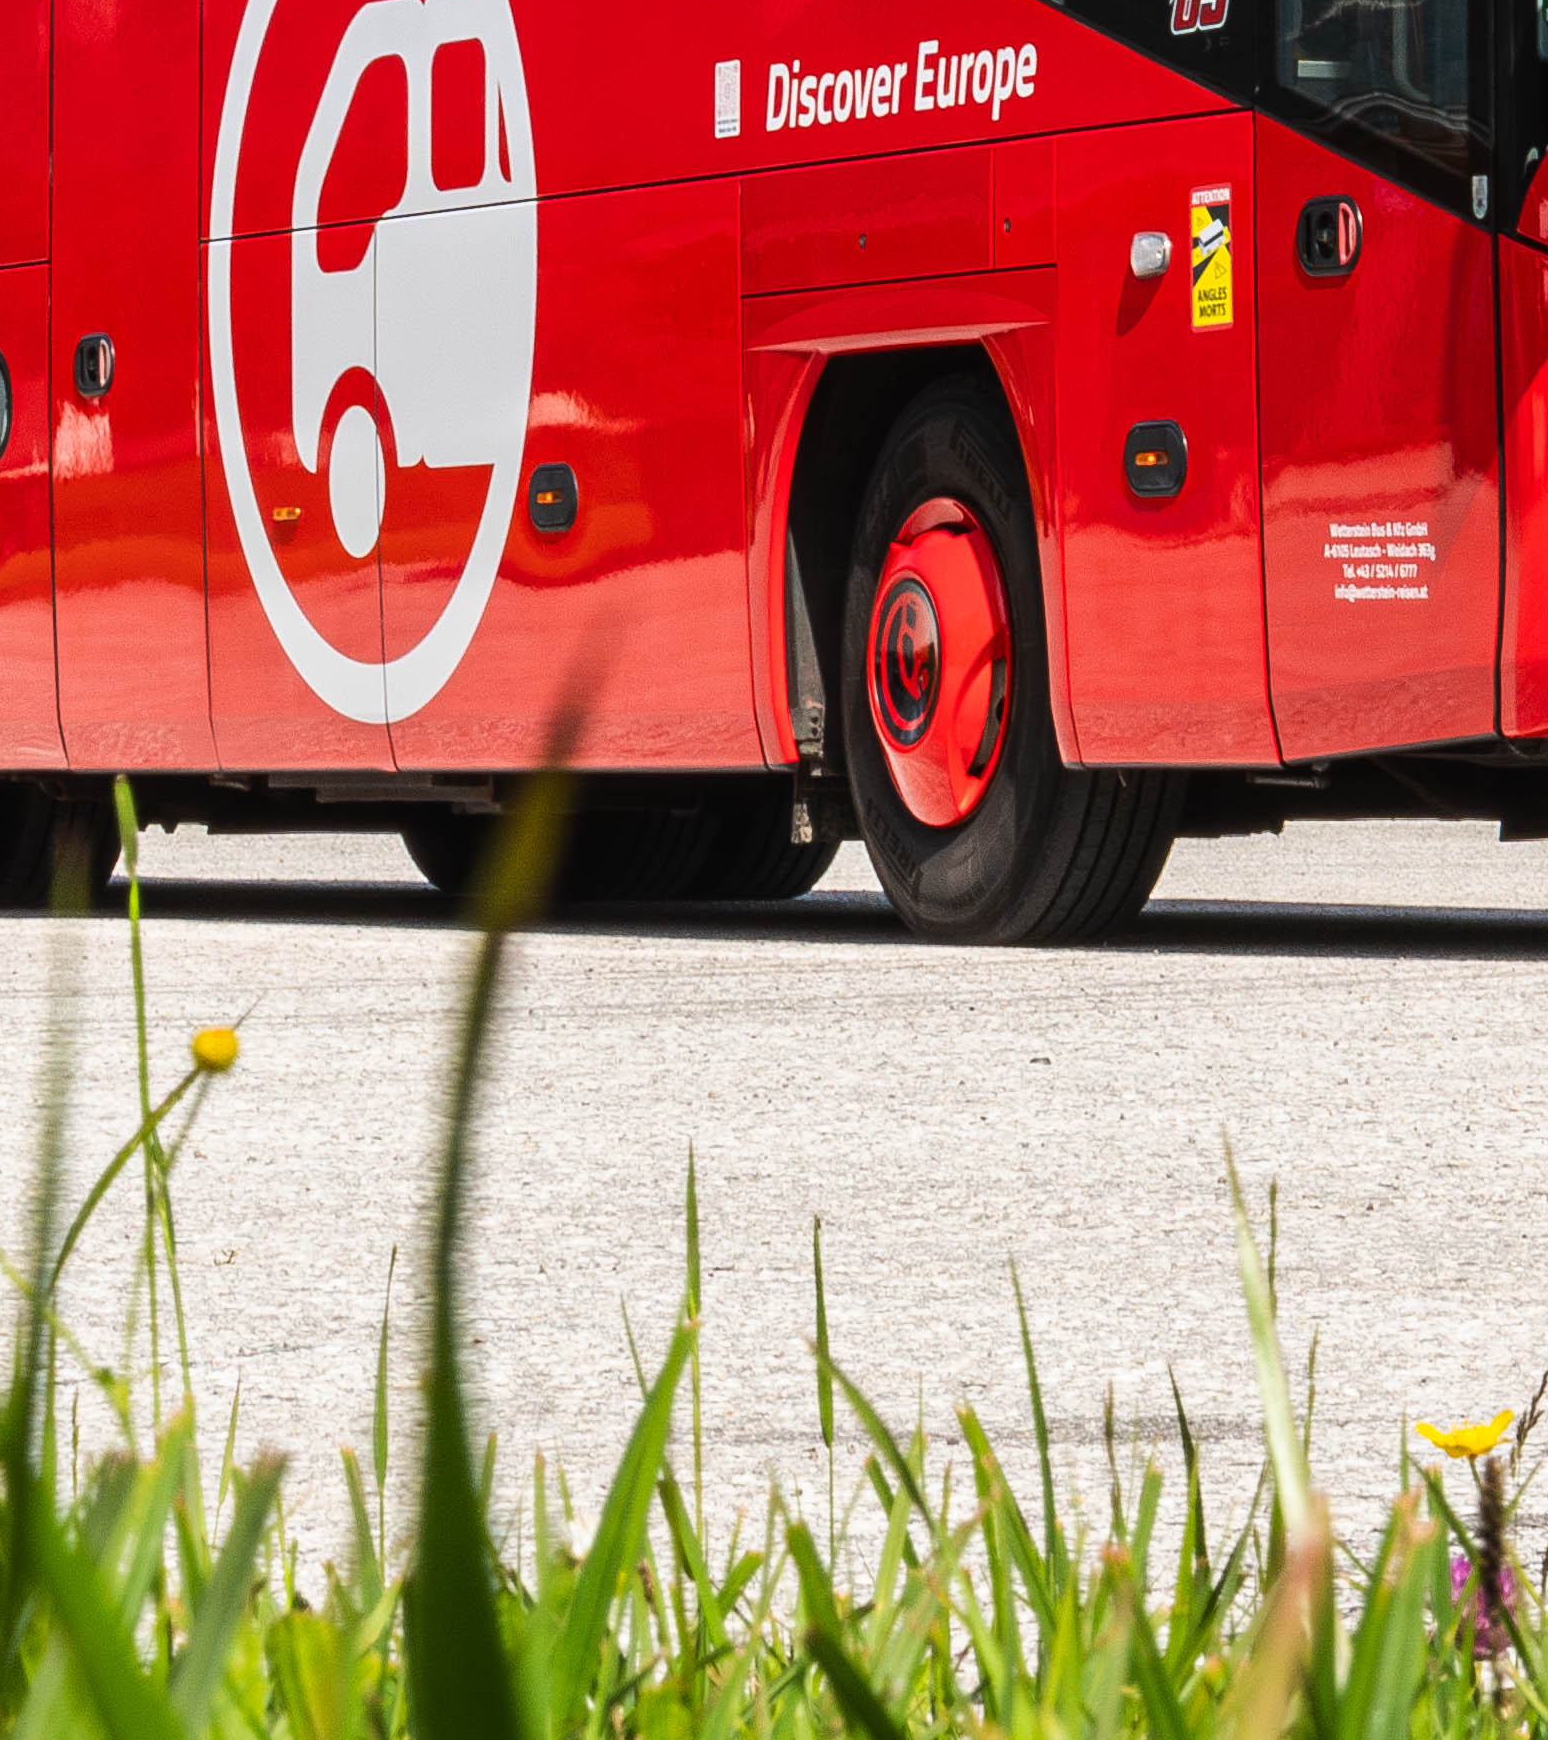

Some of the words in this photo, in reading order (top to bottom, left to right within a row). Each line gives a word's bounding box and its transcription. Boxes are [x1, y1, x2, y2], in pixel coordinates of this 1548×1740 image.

[765, 59, 908, 132] Discover
[913, 39, 1038, 122] Europe
[1191, 188, 1231, 205] ATTENTION
[1197, 286, 1228, 303] ANGLES
[1198, 303, 1227, 319] MORTS
[1329, 523, 1371, 538] Wetterstein
[1371, 522, 1385, 537] Bus
[1405, 522, 1429, 536] GmbH
[1343, 563, 1356, 578] Tel.
